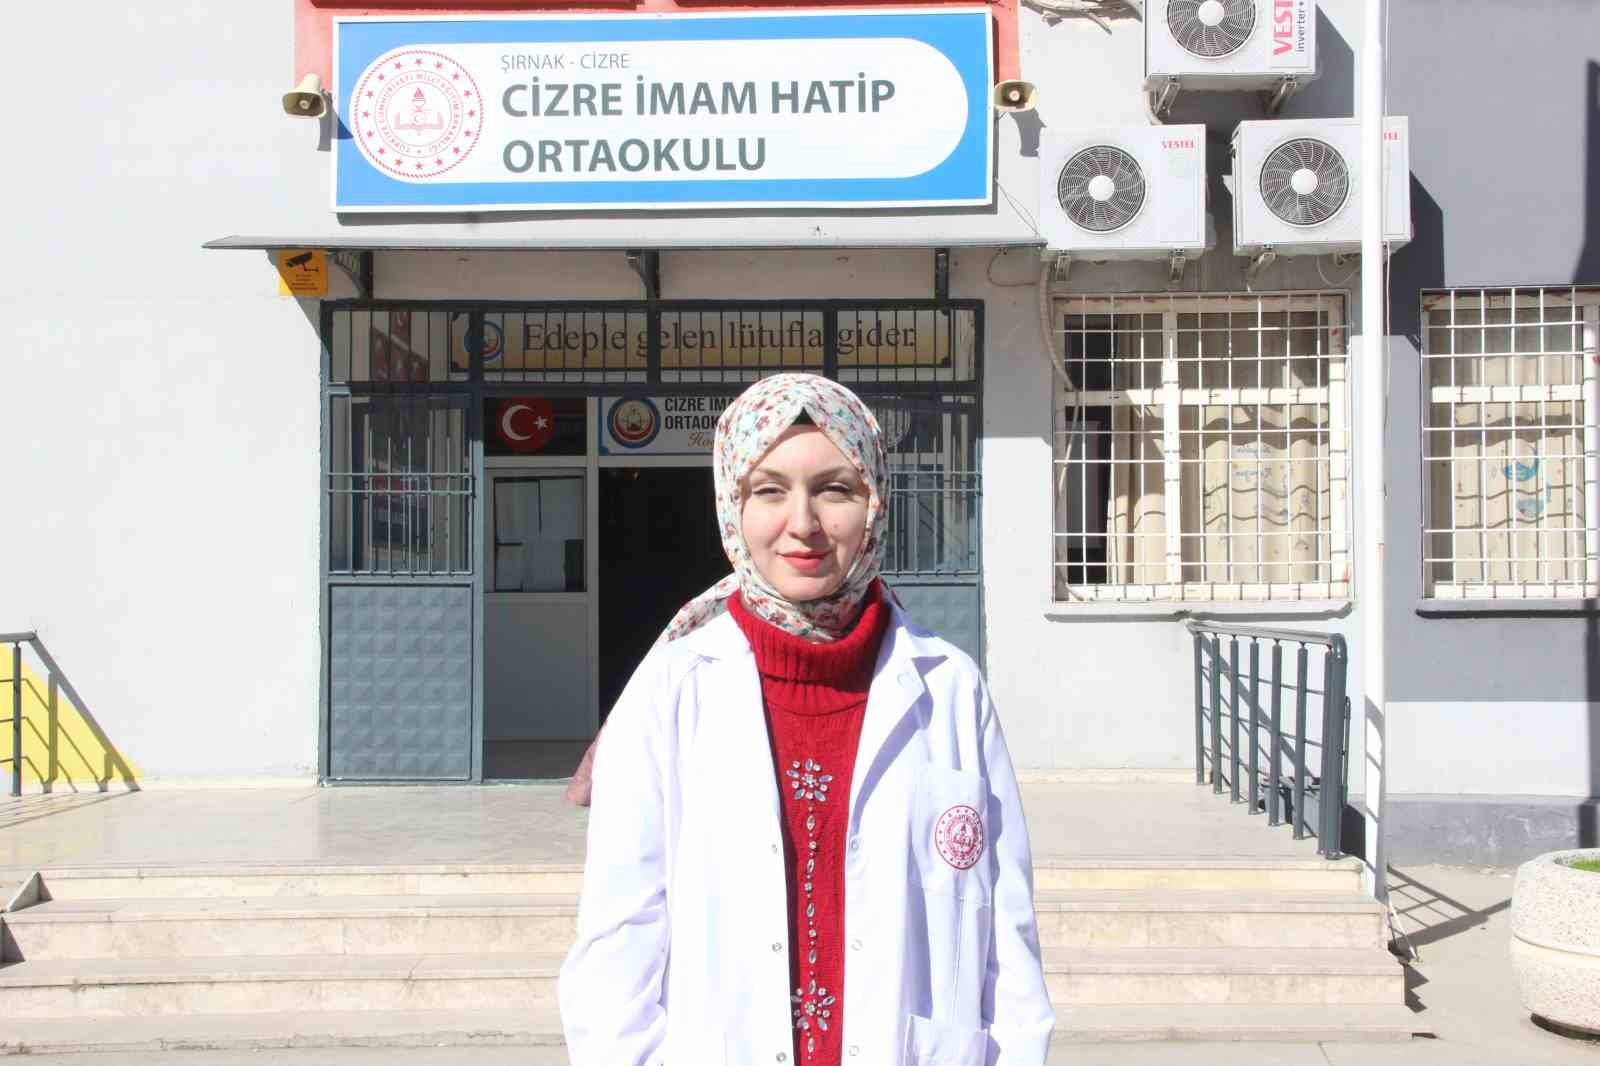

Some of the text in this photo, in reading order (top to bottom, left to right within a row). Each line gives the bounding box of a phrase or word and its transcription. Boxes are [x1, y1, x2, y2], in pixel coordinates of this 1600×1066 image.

[1273, 0, 1293, 56] VEST
[501, 53, 565, 72] ŞIRNAK
[580, 51, 631, 69] CİZRE
[502, 72, 896, 117] CİZRE İMAM HATİP
[503, 138, 766, 173] ORTAOKULU
[524, 320, 915, 358] Edeple gelen lütufla gider.
[664, 415, 720, 430] ORTAOK
